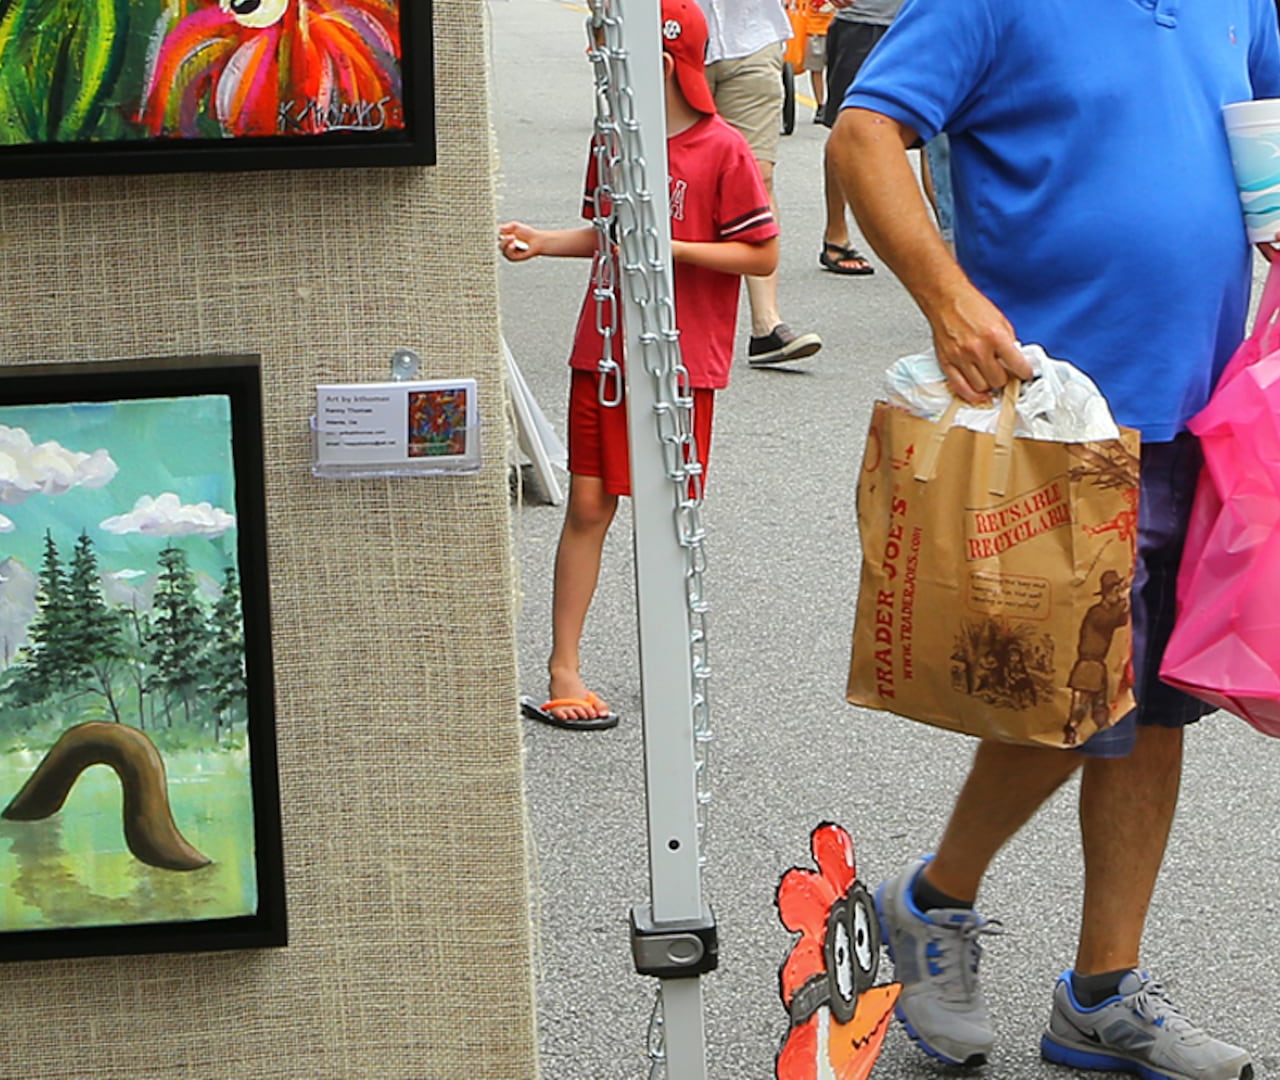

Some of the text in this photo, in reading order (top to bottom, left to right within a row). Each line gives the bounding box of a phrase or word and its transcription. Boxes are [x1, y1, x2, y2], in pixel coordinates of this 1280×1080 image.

[974, 481, 1062, 535] REUSABLE
[874, 494, 909, 701] TRADER JOE'S
